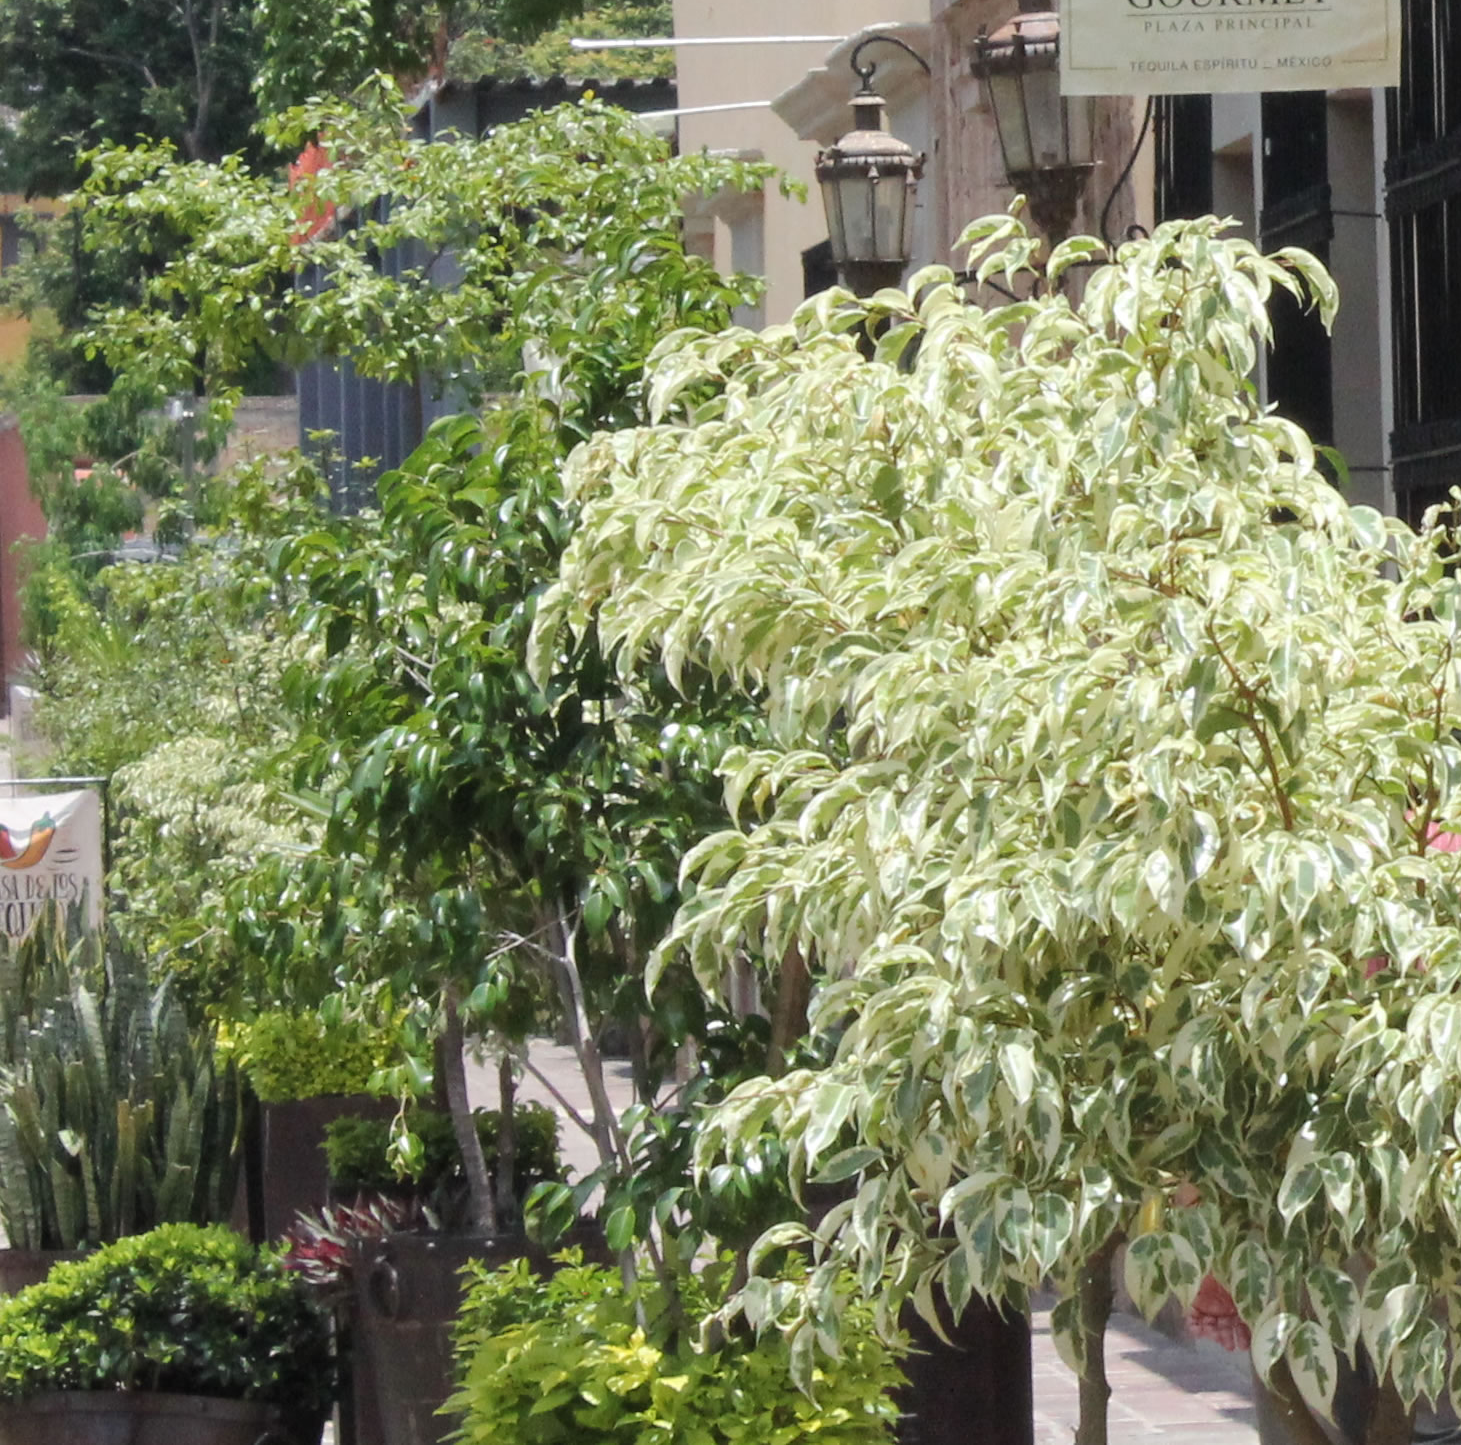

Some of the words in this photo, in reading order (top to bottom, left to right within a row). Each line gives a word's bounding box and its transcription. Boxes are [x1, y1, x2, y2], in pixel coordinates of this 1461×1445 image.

[1145, 21, 1205, 33] PLAZA
[1215, 17, 1314, 32] PRINCIPAL
[1130, 61, 1189, 73] TEQUILA
[1194, 58, 1258, 72] ESPÍRITU
[26, 875, 44, 900] DE
